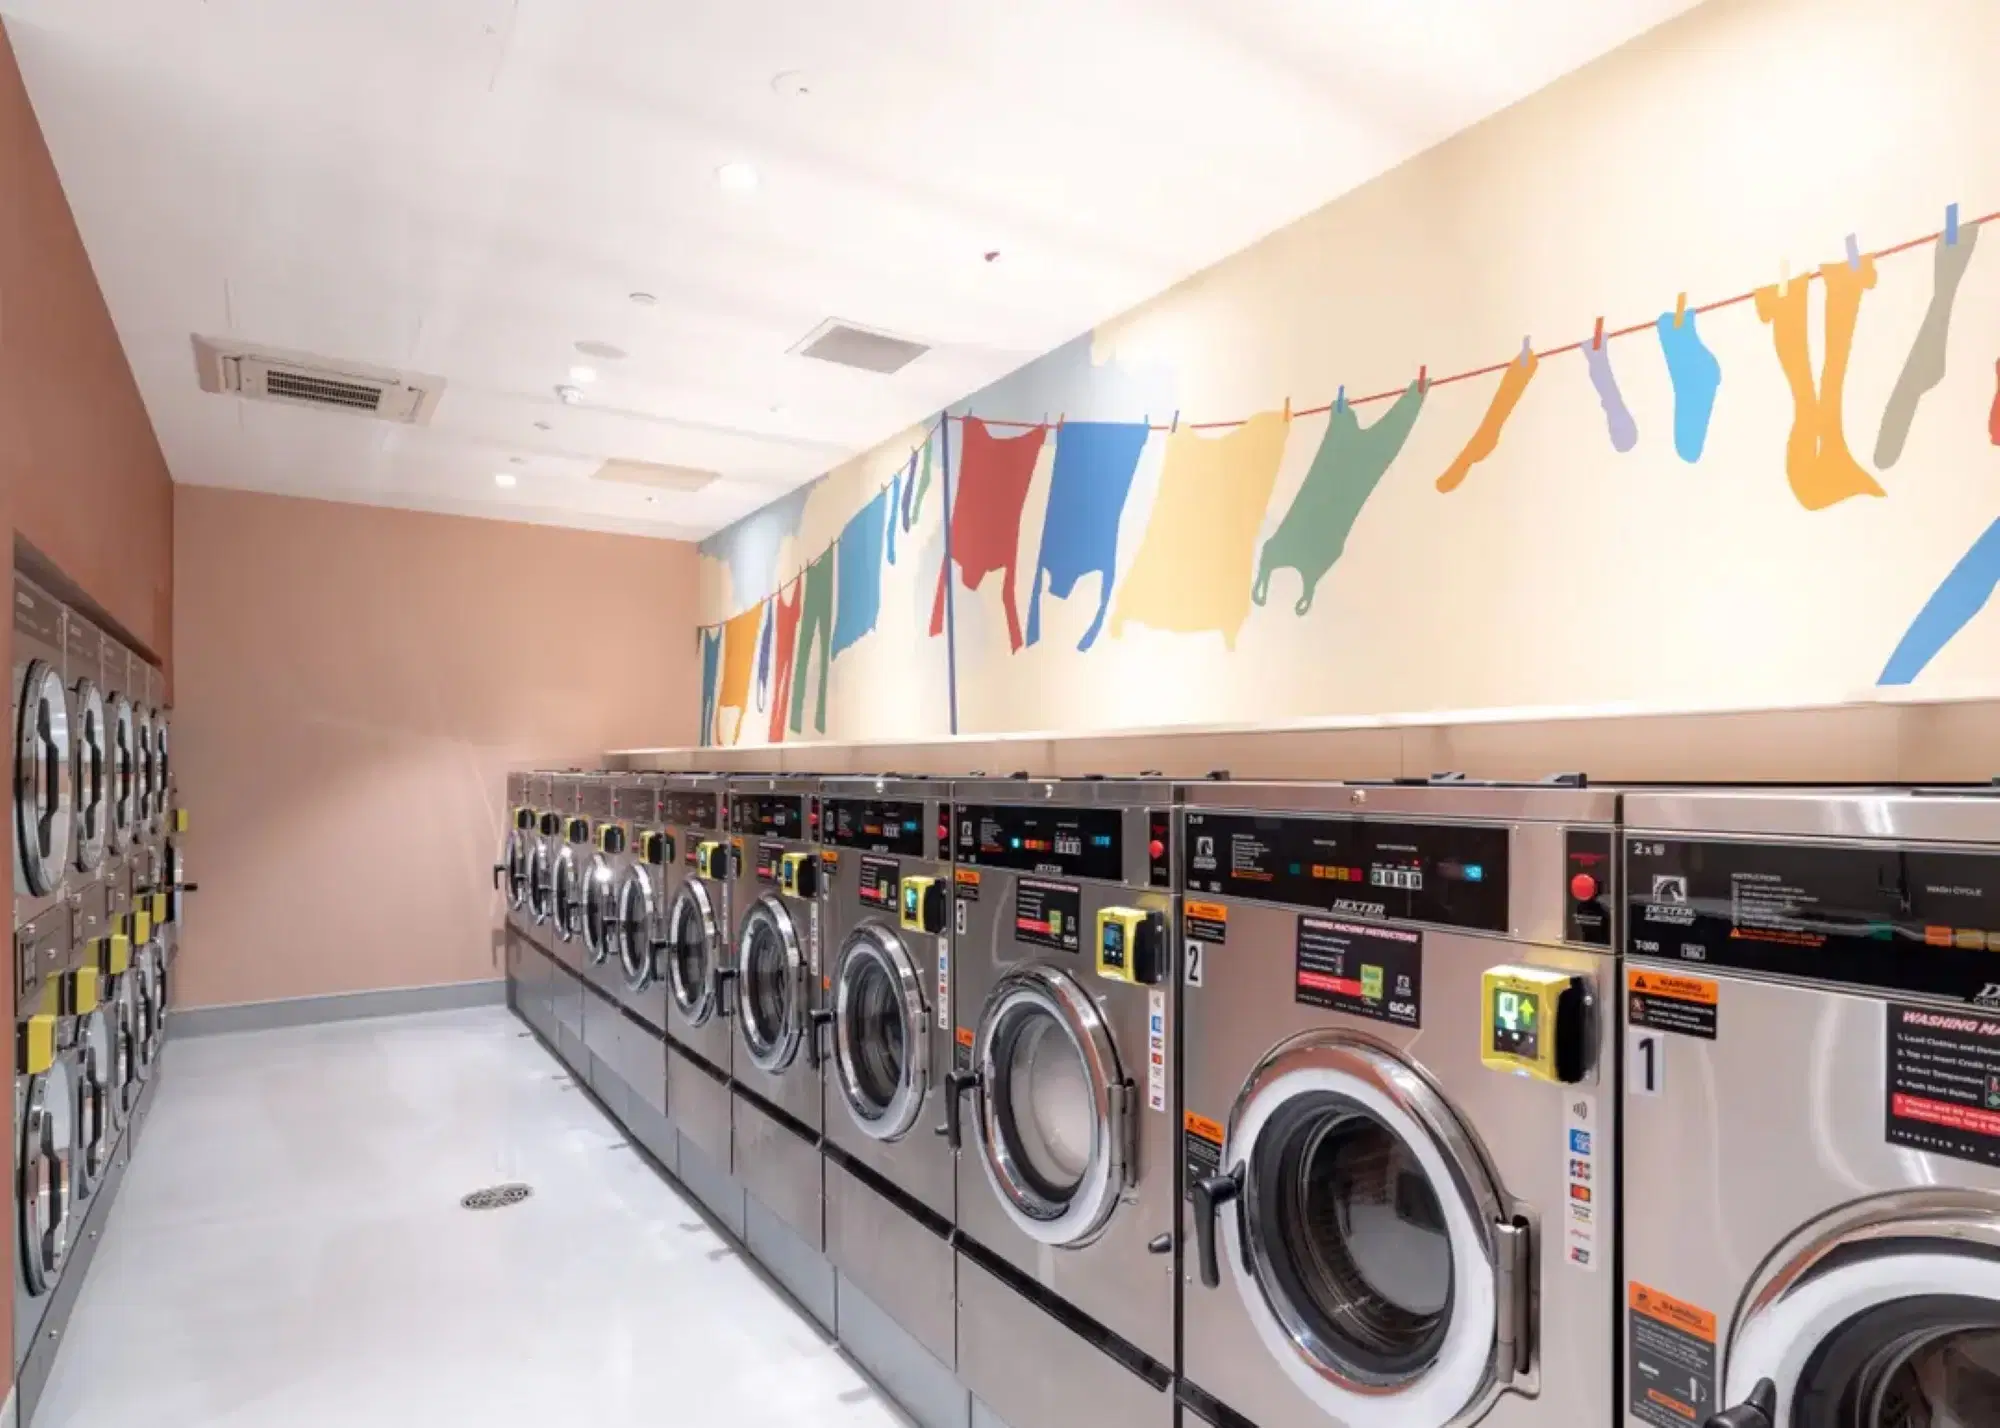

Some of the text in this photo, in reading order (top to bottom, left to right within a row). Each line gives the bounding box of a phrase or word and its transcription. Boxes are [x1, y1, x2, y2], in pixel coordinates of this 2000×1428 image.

[1333, 898, 1385, 914] DEXTER
[1188, 945, 1199, 982] 2
[1903, 1012, 1978, 1032] WASHING
[1904, 1034, 1926, 1045] Load
[1926, 1038, 1957, 1049] Clothes
[1959, 1043, 1976, 1053] and
[1637, 1037, 1655, 1092] 1
[1905, 1065, 1932, 1077] Select
[1932, 1069, 1984, 1085] Temperature
